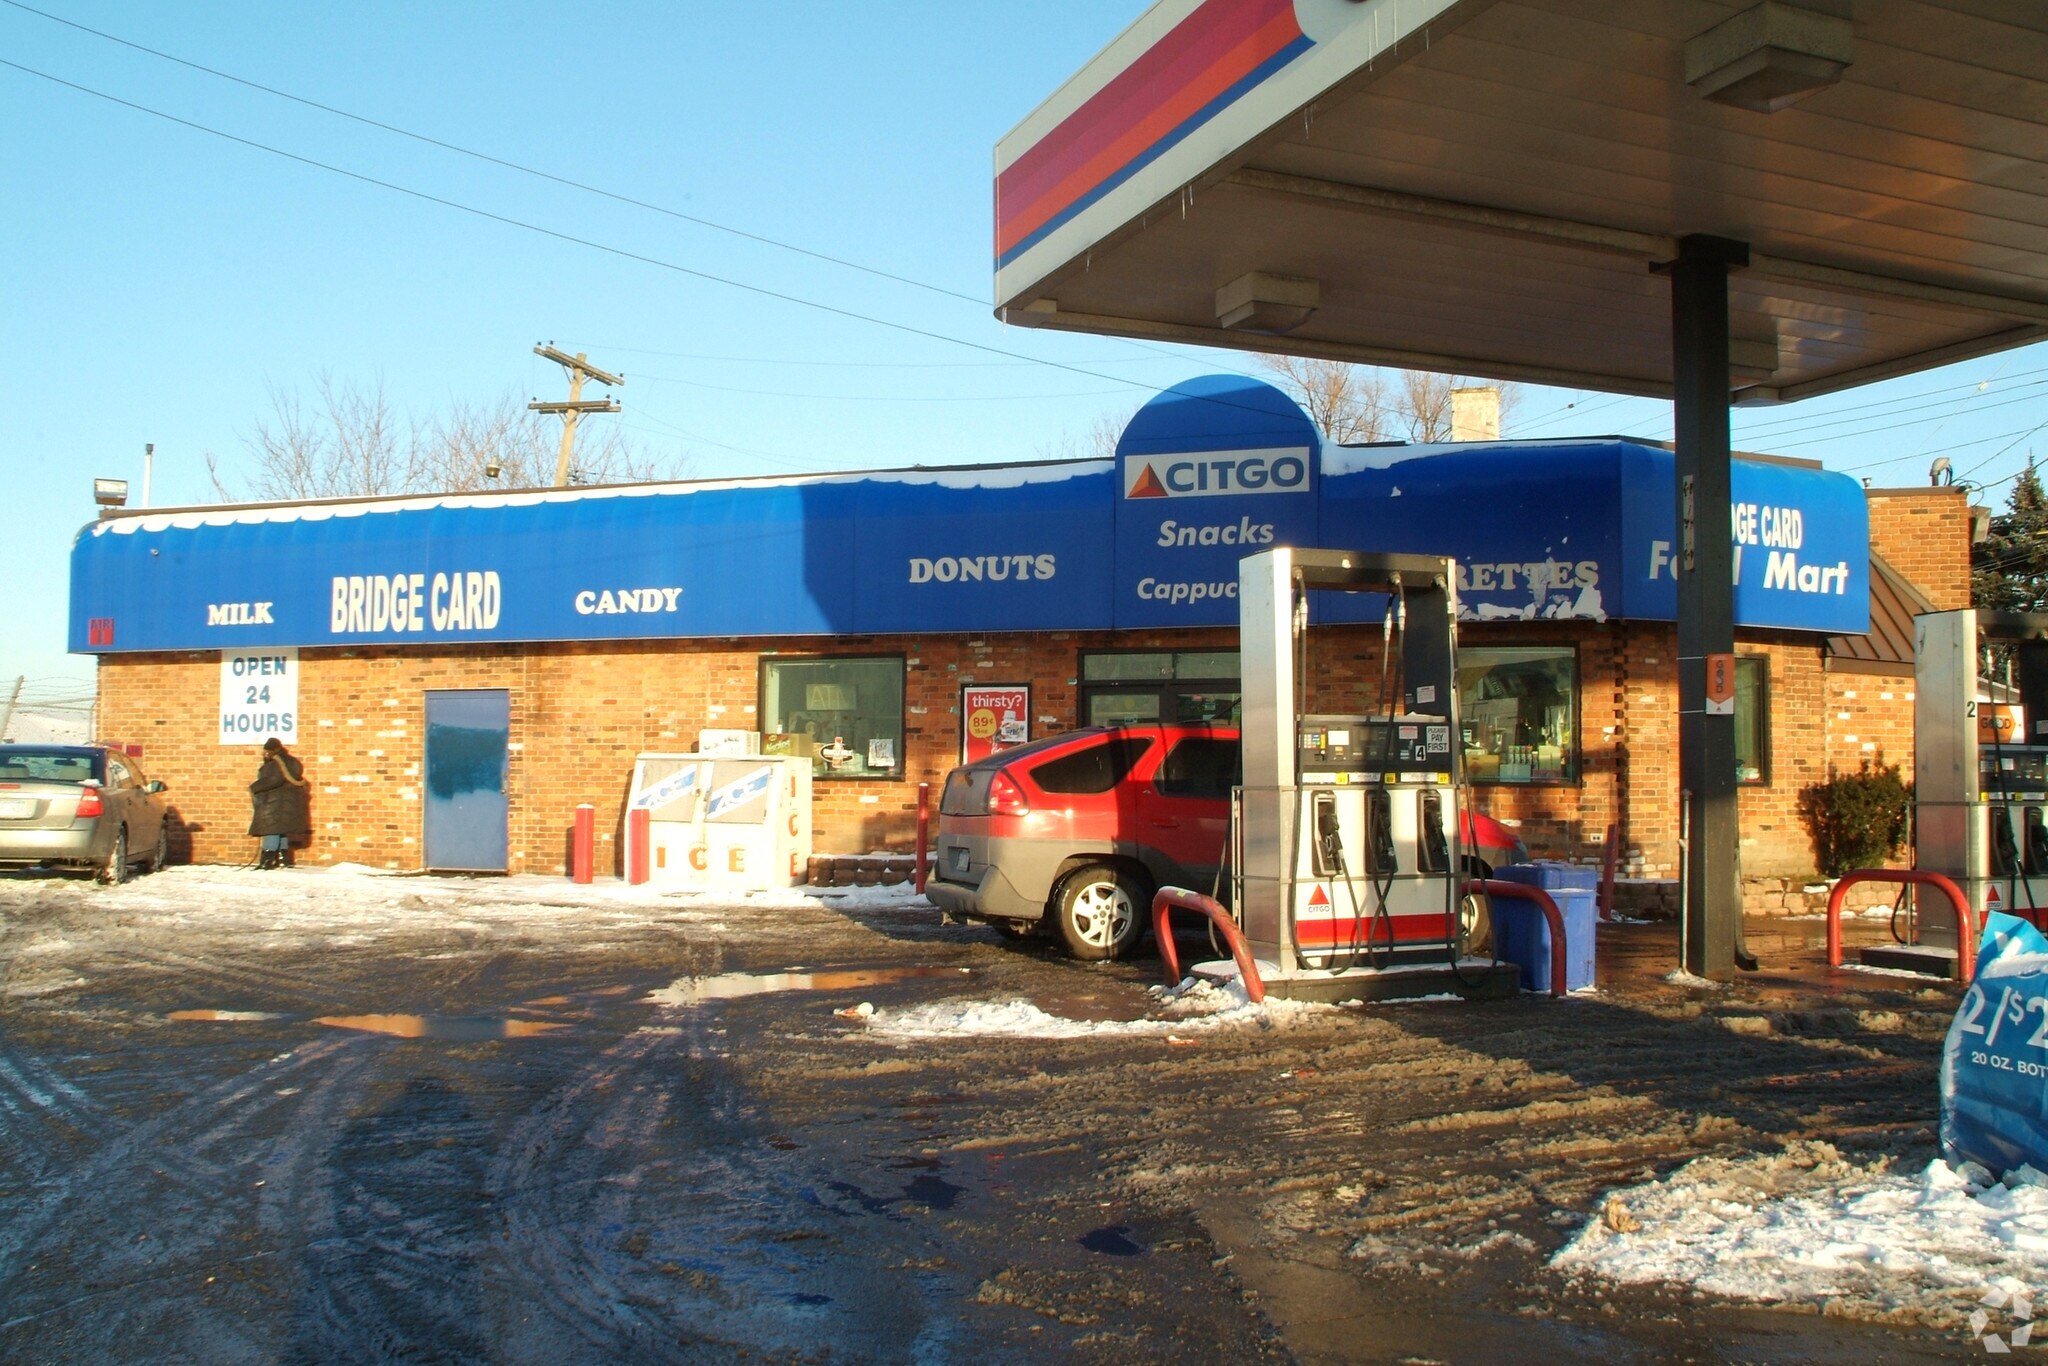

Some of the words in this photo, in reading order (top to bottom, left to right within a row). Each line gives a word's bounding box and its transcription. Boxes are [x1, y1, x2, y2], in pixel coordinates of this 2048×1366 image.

[1166, 457, 1304, 492] CITGO
[1157, 516, 1275, 547] Snacks
[1761, 505, 1803, 550] CARD
[909, 554, 1056, 583] DONUTS
[1763, 551, 1849, 595] Mart
[331, 573, 425, 633] BRIDGE
[431, 571, 501, 632] CARD
[575, 587, 683, 615] CANDY
[1137, 577, 1240, 605] Cappuc
[207, 602, 274, 626] MILK
[232, 656, 287, 676] OPEN
[246, 685, 271, 704] 24
[972, 694, 1023, 709] thirsty?
[1967, 701, 1976, 718] 2
[223, 713, 293, 733] HOURS
[1427, 743, 1448, 751] FIRST
[1431, 734, 1444, 742] PAY
[1416, 746, 1425, 760] 4
[657, 846, 745, 872] ICE
[1307, 905, 1330, 913] CITGO
[1971, 1050, 1987, 1065] 20
[1990, 1055, 2014, 1070] OZ.
[2017, 1060, 2048, 1078] BOT
